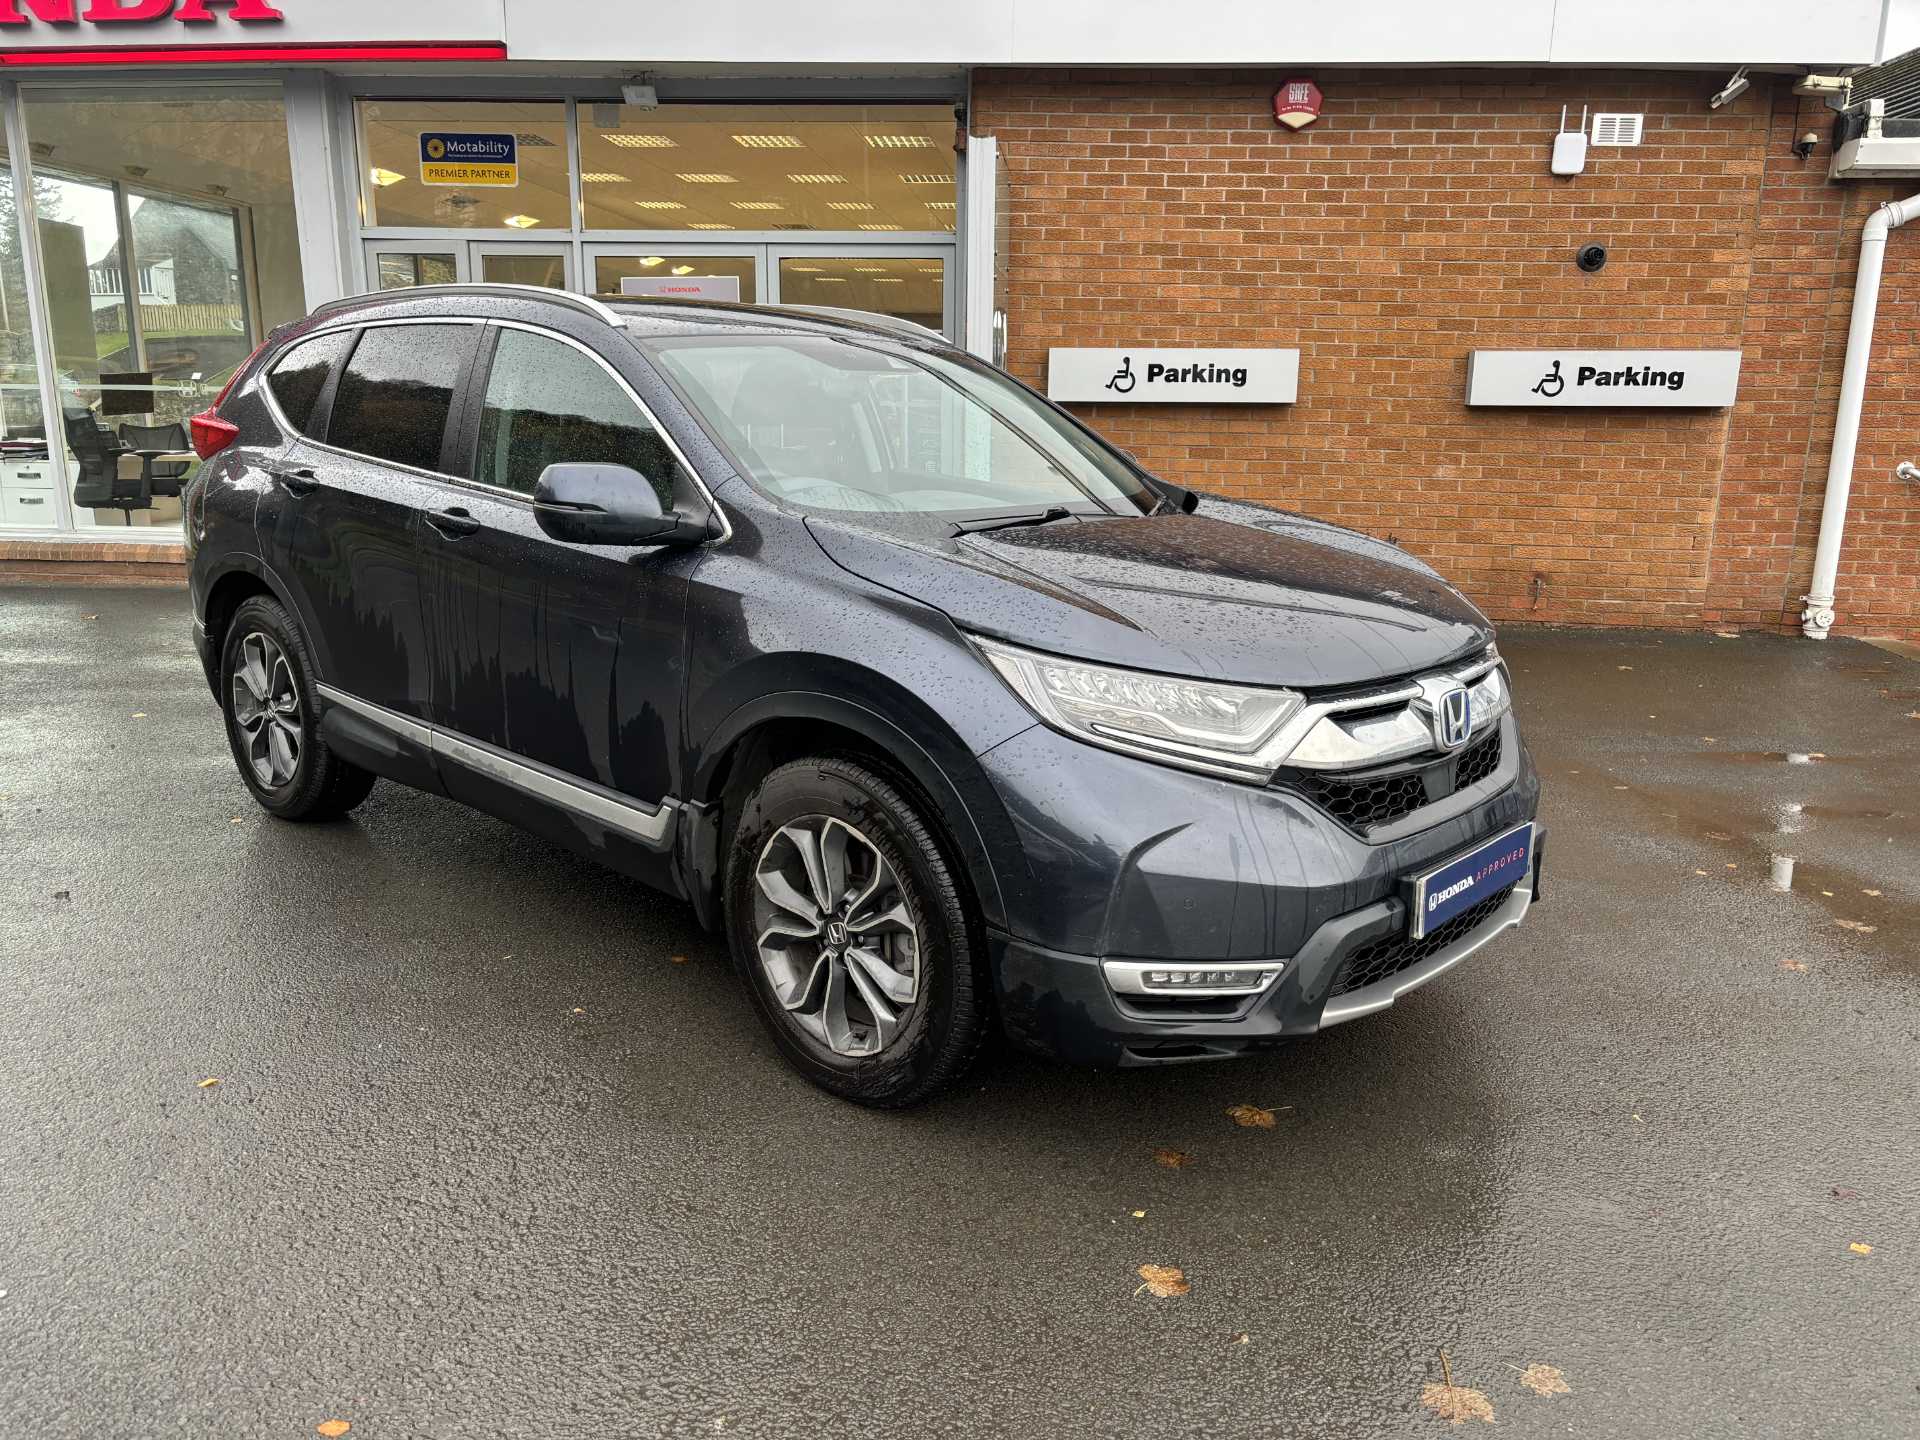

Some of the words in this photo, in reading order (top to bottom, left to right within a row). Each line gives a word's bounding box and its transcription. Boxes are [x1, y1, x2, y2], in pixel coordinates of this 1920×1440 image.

[446, 140, 510, 157] Motability
[428, 168, 469, 178] PREMIER
[470, 169, 511, 179] PARTNER
[1147, 363, 1248, 388] Parking
[1576, 365, 1685, 391] Parking
[1437, 875, 1475, 905] HONDA
[1475, 847, 1525, 881] APPROVED
